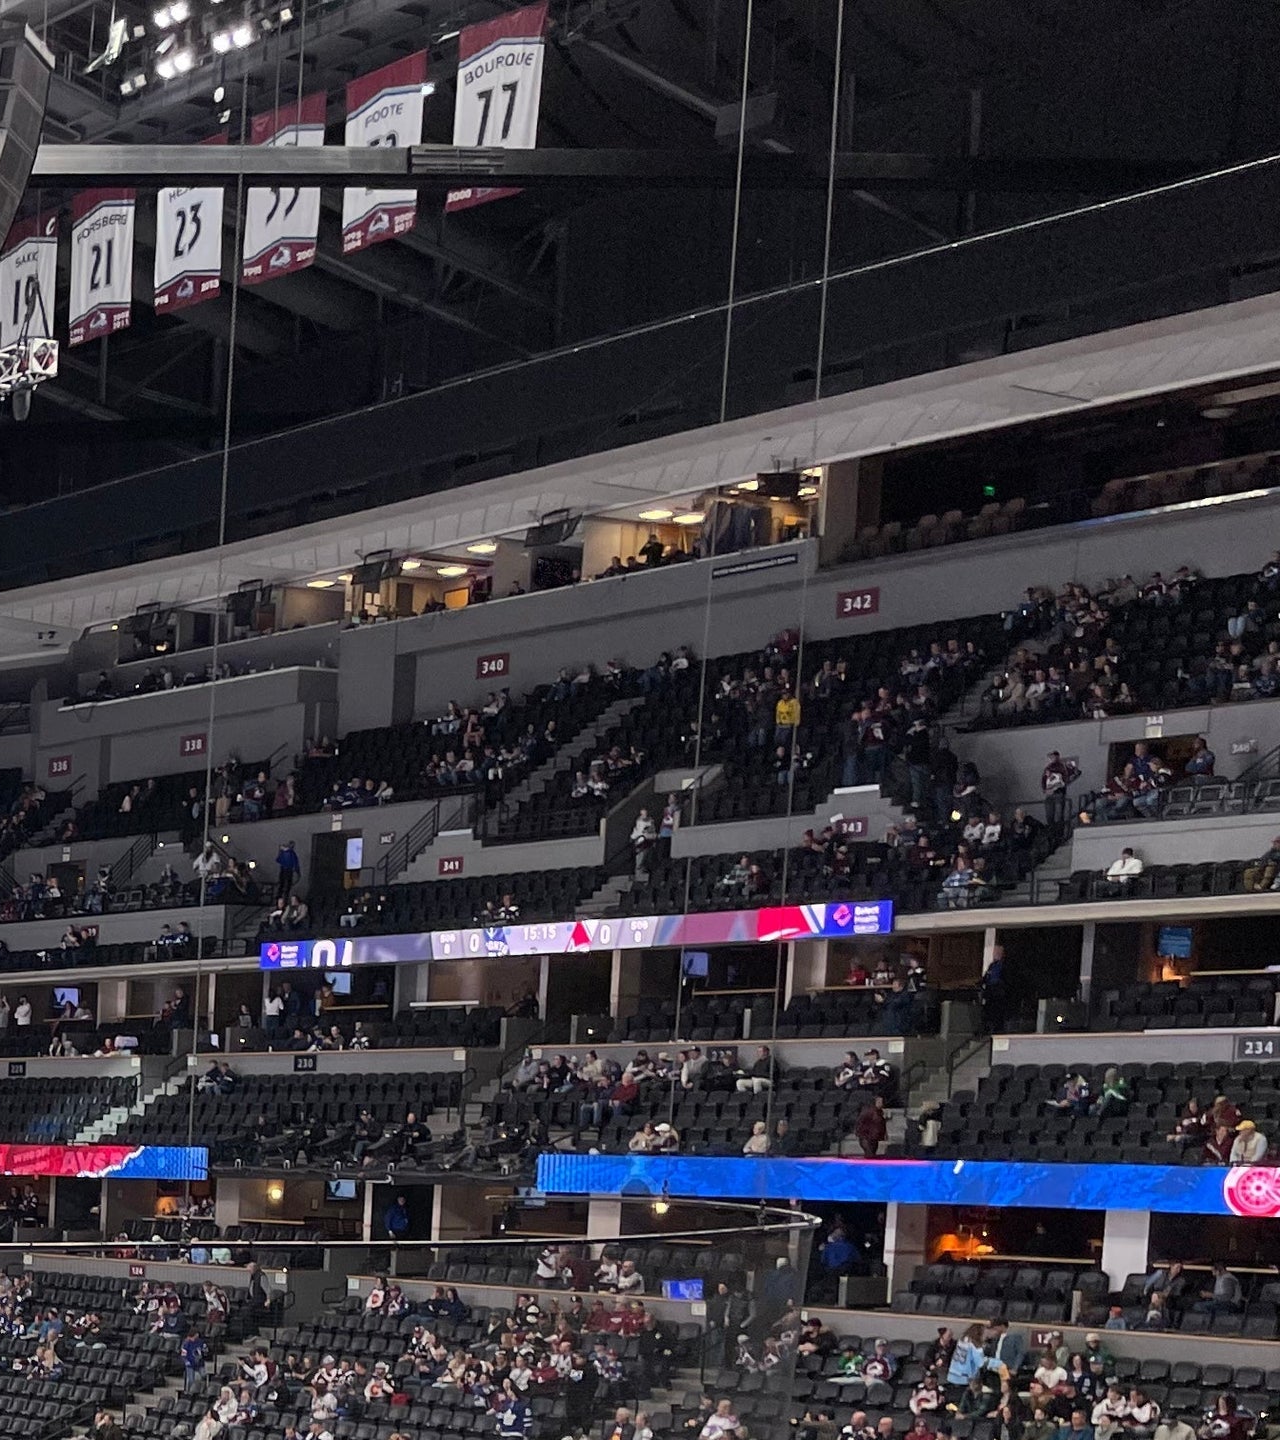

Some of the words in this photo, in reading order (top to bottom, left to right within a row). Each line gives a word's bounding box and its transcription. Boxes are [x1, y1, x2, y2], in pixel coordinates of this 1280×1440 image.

[464, 51, 536, 87] BOURQUE
[364, 102, 405, 129] FOOTE
[76, 211, 128, 245] FORSBERG
[174, 201, 204, 258] 23
[90, 238, 114, 291] 21
[843, 593, 873, 612] 342
[481, 659, 505, 674] 340
[184, 739, 202, 751] 338
[51, 761, 68, 773] 336
[443, 860, 460, 871] 341
[469, 934, 480, 953] 0
[522, 926, 557, 942] 15:15
[599, 926, 611, 945] 0
[1244, 1041, 1274, 1055] 234
[297, 1058, 314, 1069] 230
